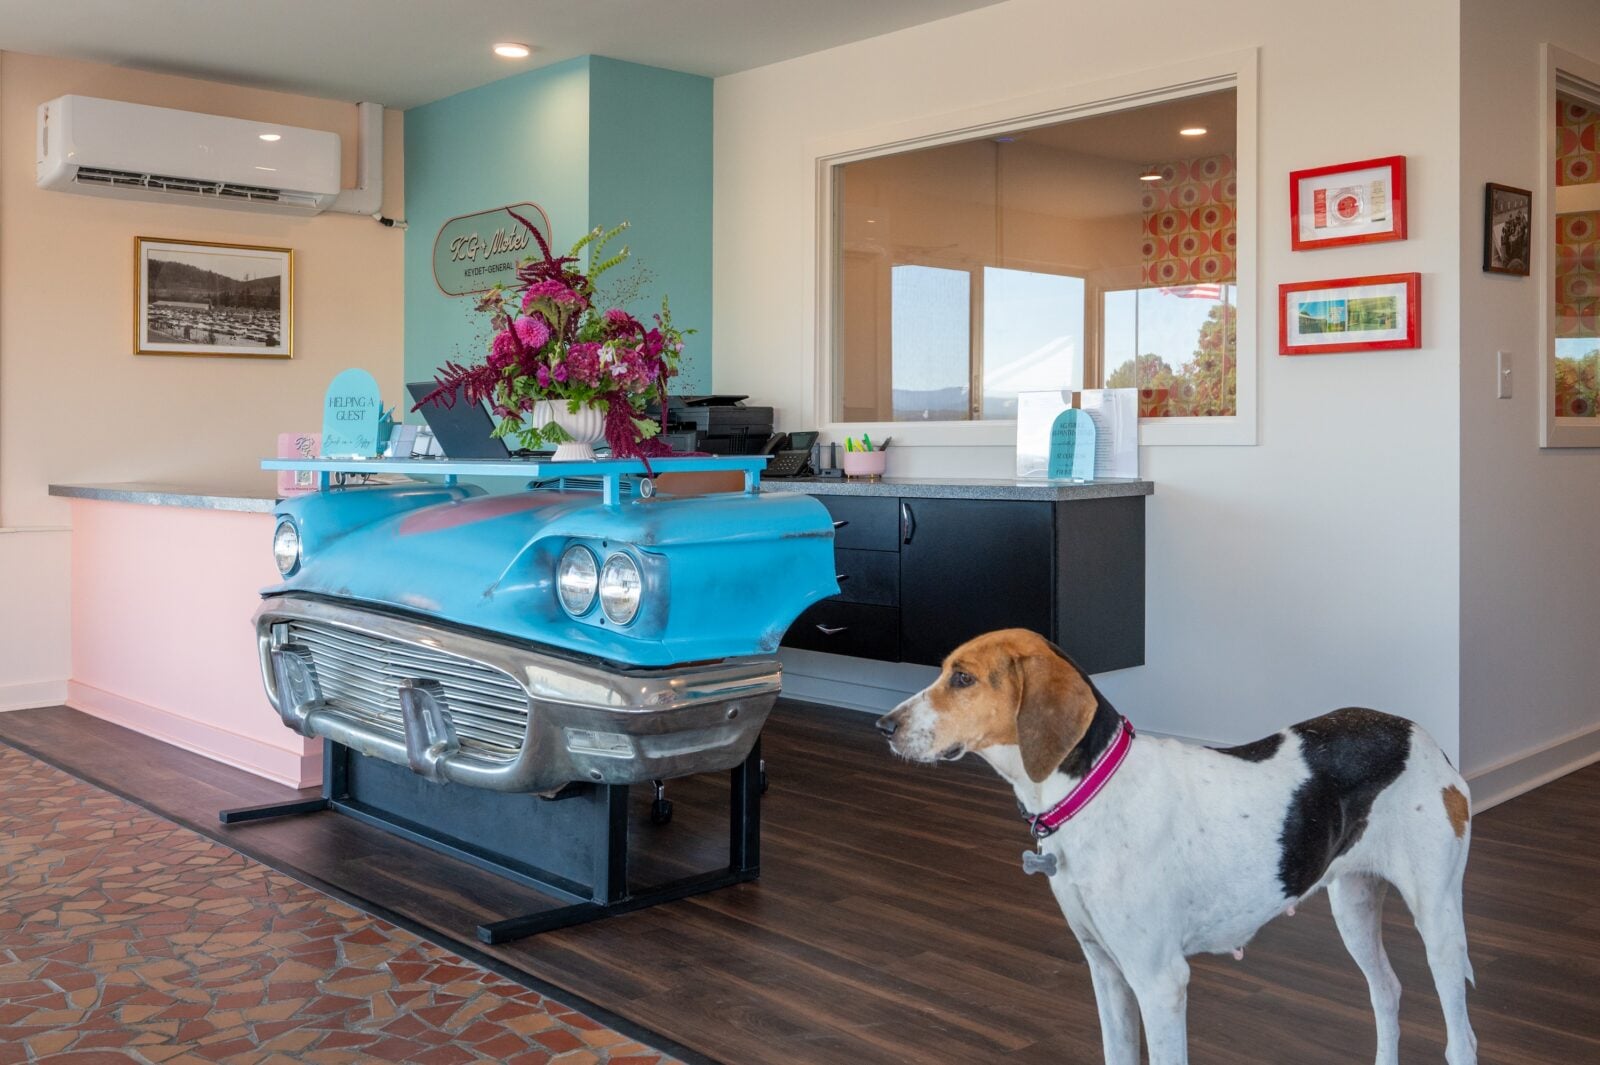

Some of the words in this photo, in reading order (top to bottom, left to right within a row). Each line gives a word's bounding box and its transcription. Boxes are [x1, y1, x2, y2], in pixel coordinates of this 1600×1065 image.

[451, 232, 479, 262] KG
[484, 224, 529, 259] Motel
[464, 262, 514, 277] KEYDET-GENERAL
[329, 396, 366, 408] HELPING
[368, 396, 374, 407] A
[336, 410, 366, 421] GUEST
